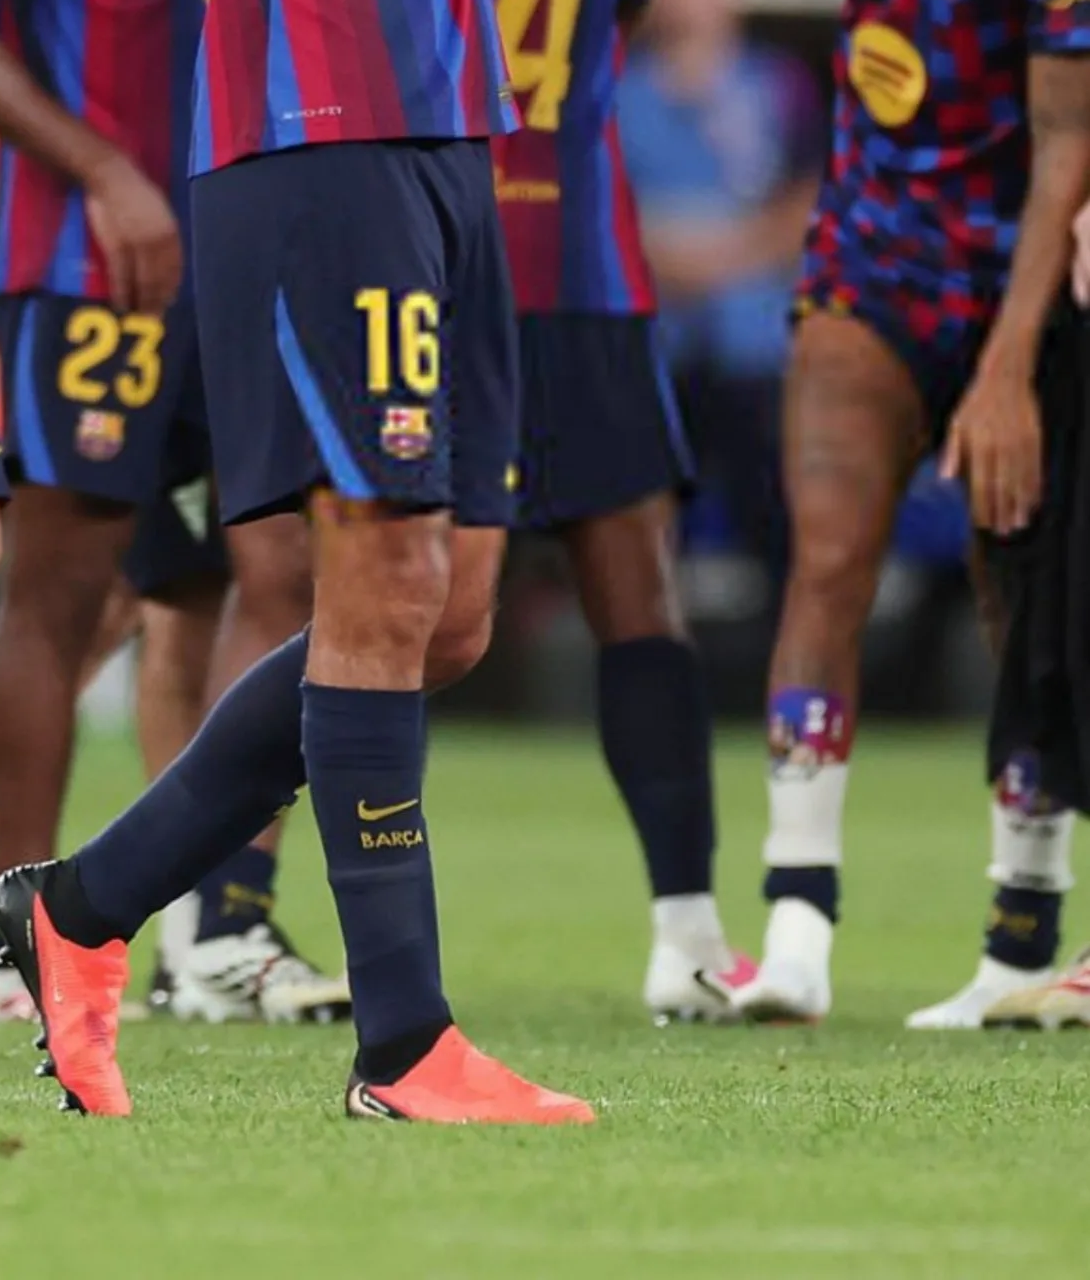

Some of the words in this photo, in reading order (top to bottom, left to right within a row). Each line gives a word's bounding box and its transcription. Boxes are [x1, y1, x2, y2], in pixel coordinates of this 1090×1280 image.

[58, 306, 166, 408] 23
[355, 288, 440, 395] 16
[359, 828, 423, 849] BARÇA
